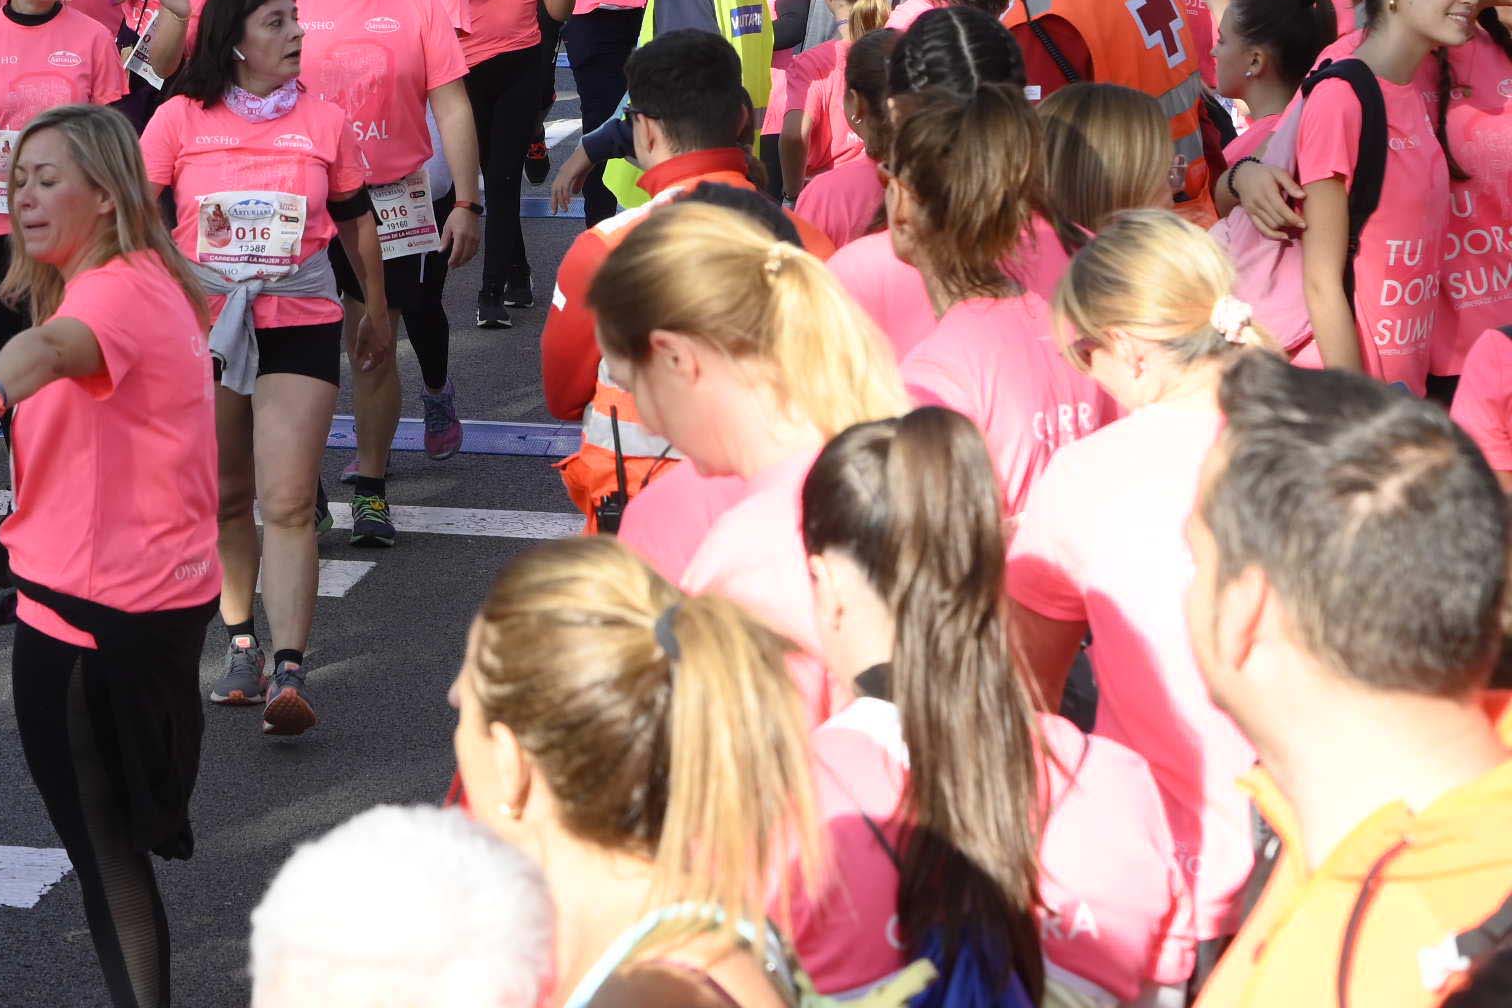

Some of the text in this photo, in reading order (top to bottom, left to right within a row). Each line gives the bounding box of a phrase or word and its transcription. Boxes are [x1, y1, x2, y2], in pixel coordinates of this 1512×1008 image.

[380, 205, 408, 220] 016
[235, 226, 271, 240] 016
[249, 255, 258, 263] LA
[258, 256, 280, 264] MUJER
[1386, 239, 1424, 266] TU
